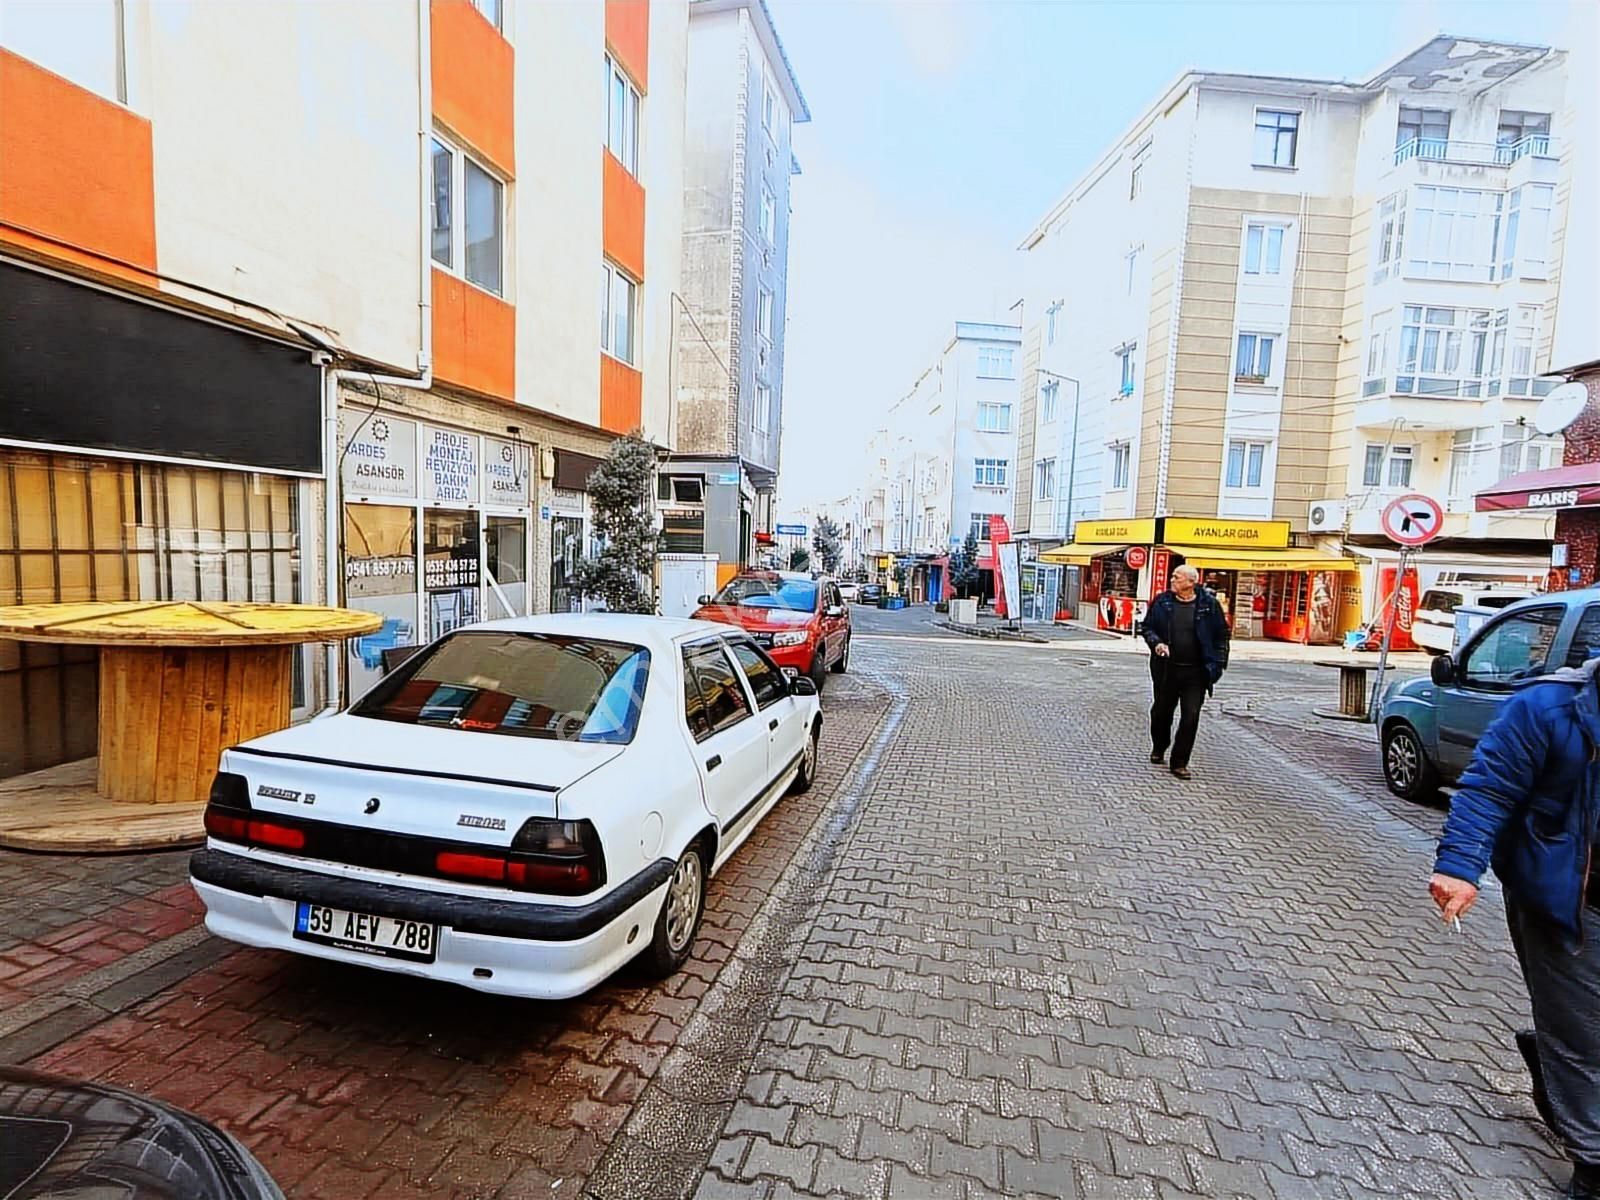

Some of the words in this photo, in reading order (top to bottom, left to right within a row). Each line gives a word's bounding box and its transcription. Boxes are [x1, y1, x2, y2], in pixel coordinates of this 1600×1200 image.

[434, 431, 469, 449] PROJE
[429, 444, 472, 462] MONTAJ
[356, 463, 405, 480] ASANSÖR
[434, 472, 469, 487] BAKIM
[436, 487, 467, 500] ARIZA
[1527, 490, 1579, 507] BARIŞ
[1193, 527, 1236, 538] AYANLAR
[1237, 530, 1259, 539] GIDA
[346, 562, 371, 577] 0541
[310, 904, 334, 934] 59
[343, 911, 381, 943] AEV
[392, 919, 432, 951] 788
